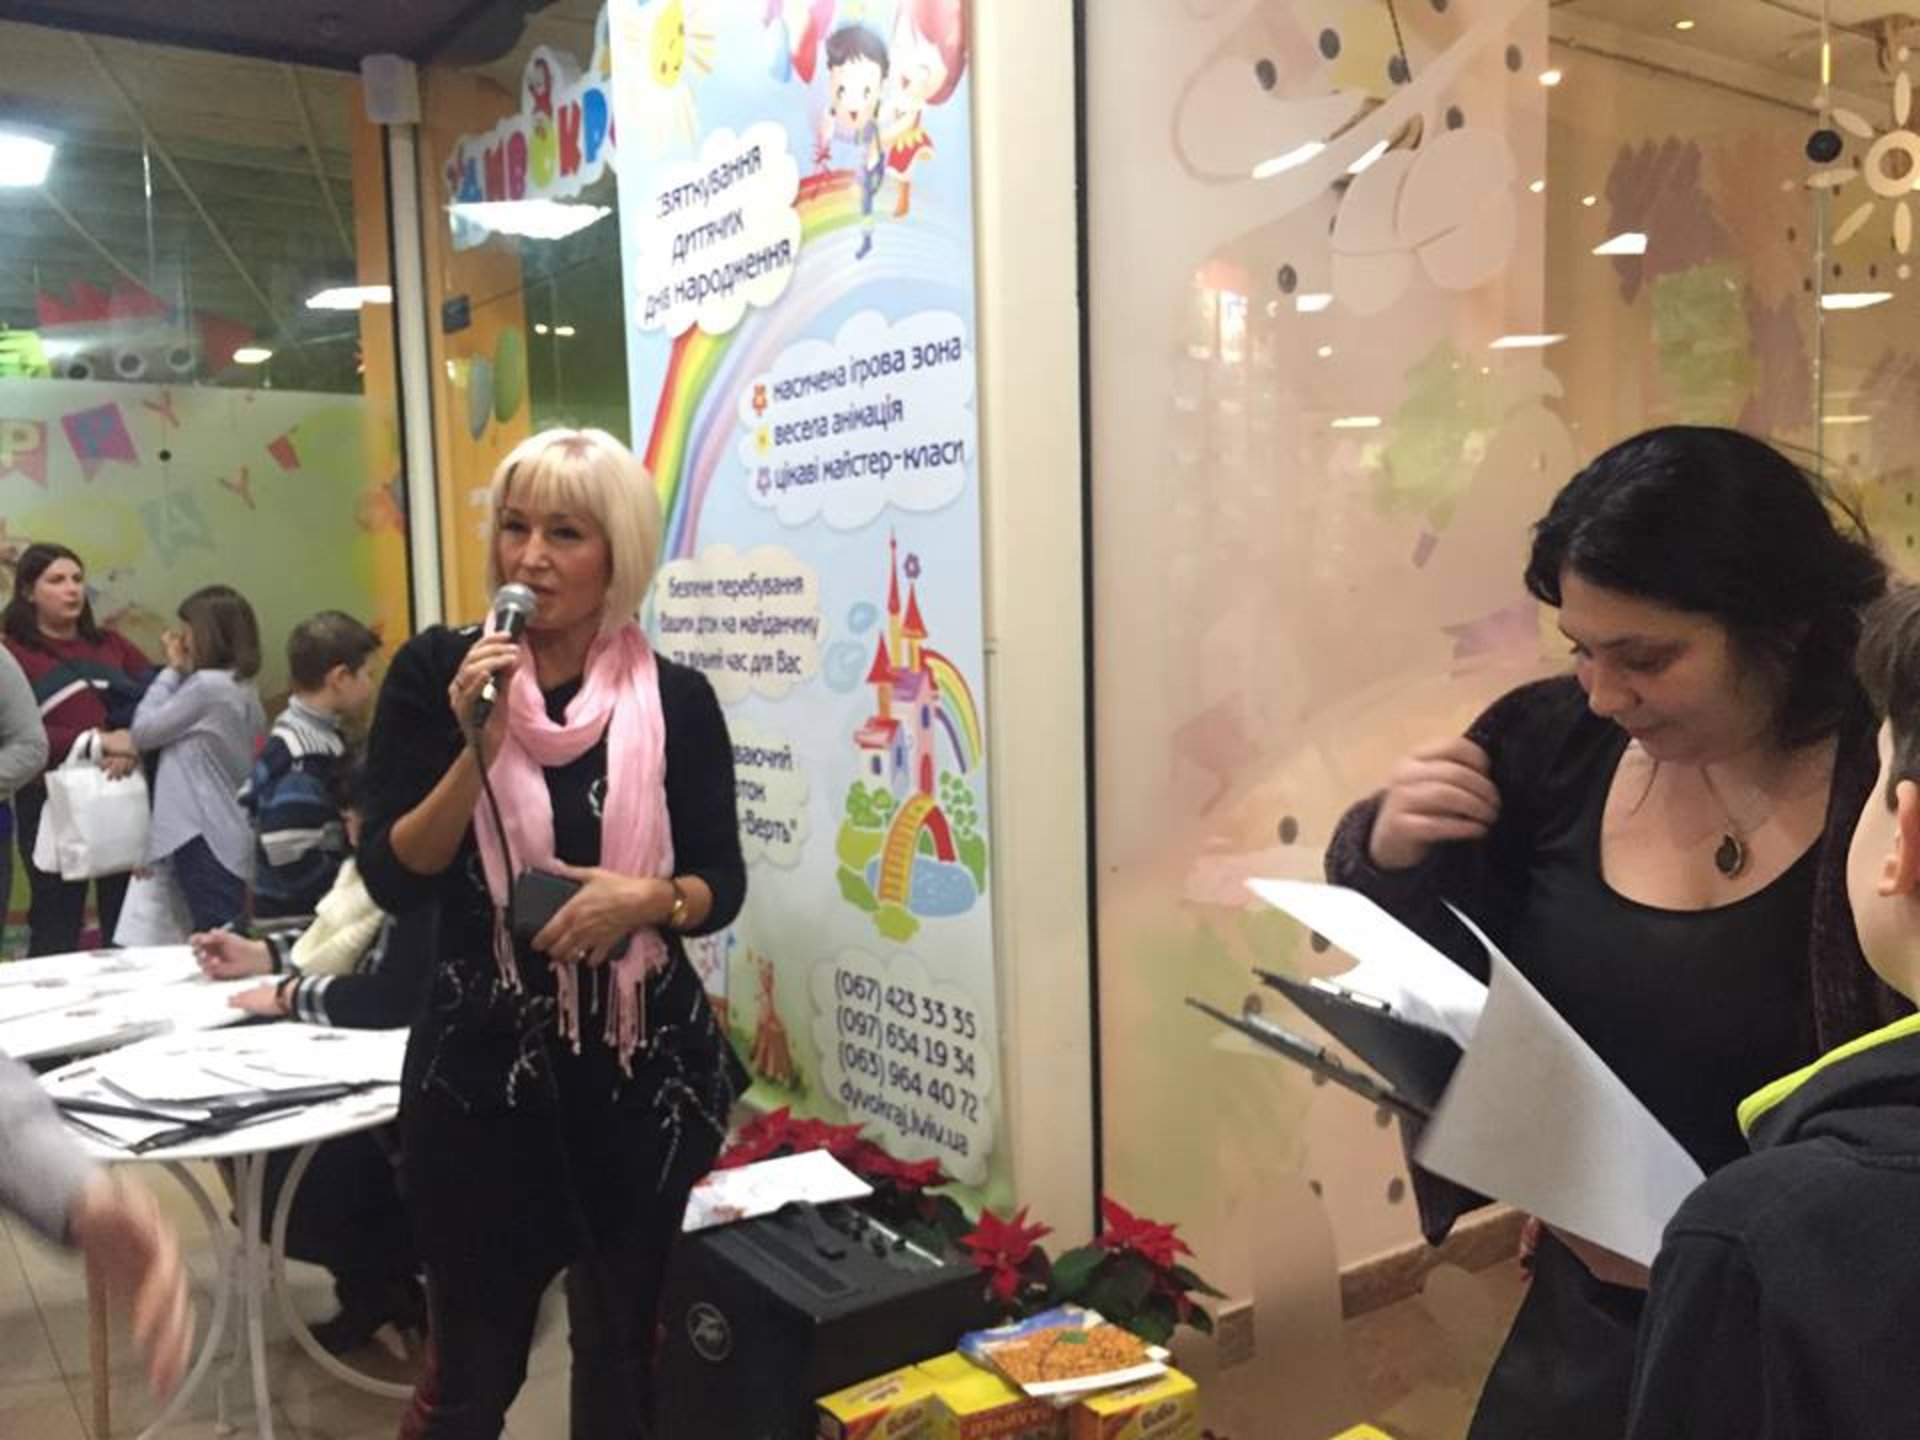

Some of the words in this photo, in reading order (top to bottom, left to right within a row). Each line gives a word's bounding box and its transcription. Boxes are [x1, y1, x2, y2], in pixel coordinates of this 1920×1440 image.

[656, 144, 762, 220] вяткування
[675, 238, 792, 304] народження
[851, 350, 906, 388] ігрова
[911, 336, 962, 370] зона
[774, 415, 829, 446] весела
[832, 394, 904, 432] анімація
[721, 617, 737, 634] на
[726, 653, 748, 672] час
[777, 649, 802, 675] Вас
[732, 744, 792, 771] ваючий
[835, 967, 882, 1013] (067)
[885, 985, 917, 1019] 423
[921, 996, 947, 1028] 33
[952, 1006, 976, 1040] 35
[837, 1004, 883, 1050] (097)
[886, 1022, 919, 1058] 654
[925, 1035, 948, 1067] 19
[953, 1045, 976, 1080] 34
[889, 1060, 922, 1097] 964
[928, 1078, 956, 1110] 40
[961, 1088, 979, 1124] 72
